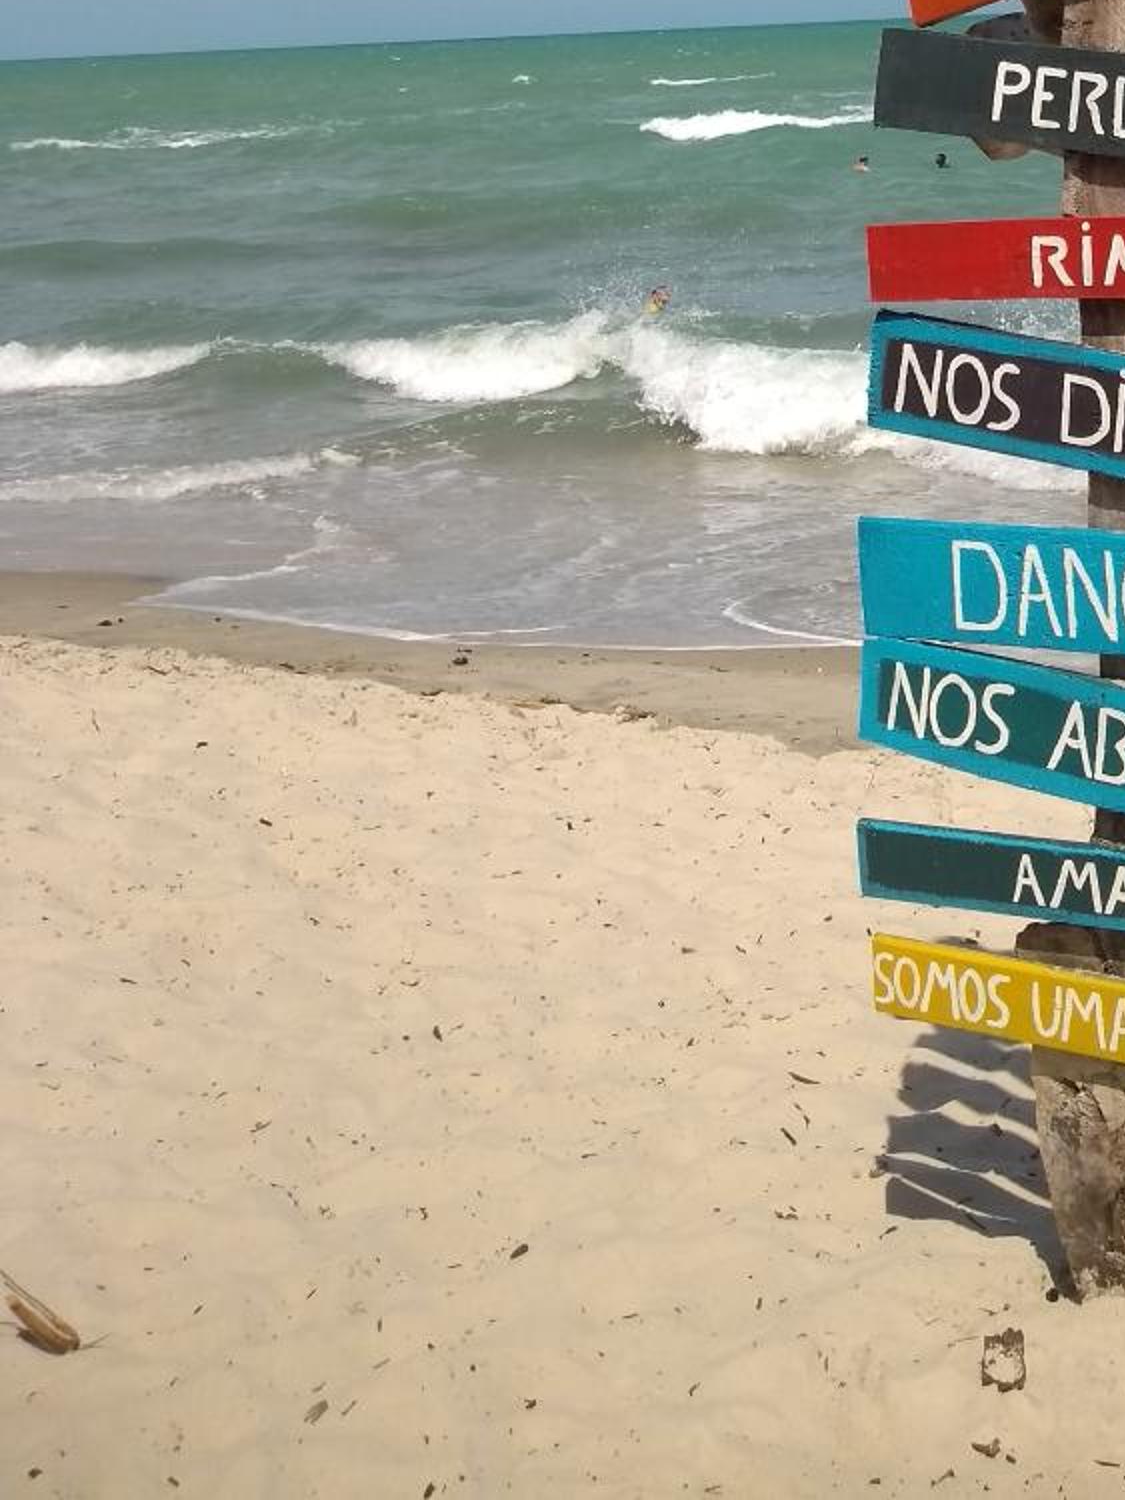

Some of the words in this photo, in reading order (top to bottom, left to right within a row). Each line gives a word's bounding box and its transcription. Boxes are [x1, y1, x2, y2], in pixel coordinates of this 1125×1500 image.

[894, 343, 1021, 432] NOS
[887, 662, 1016, 755] NOS
[874, 951, 1011, 1029] SOMOS
